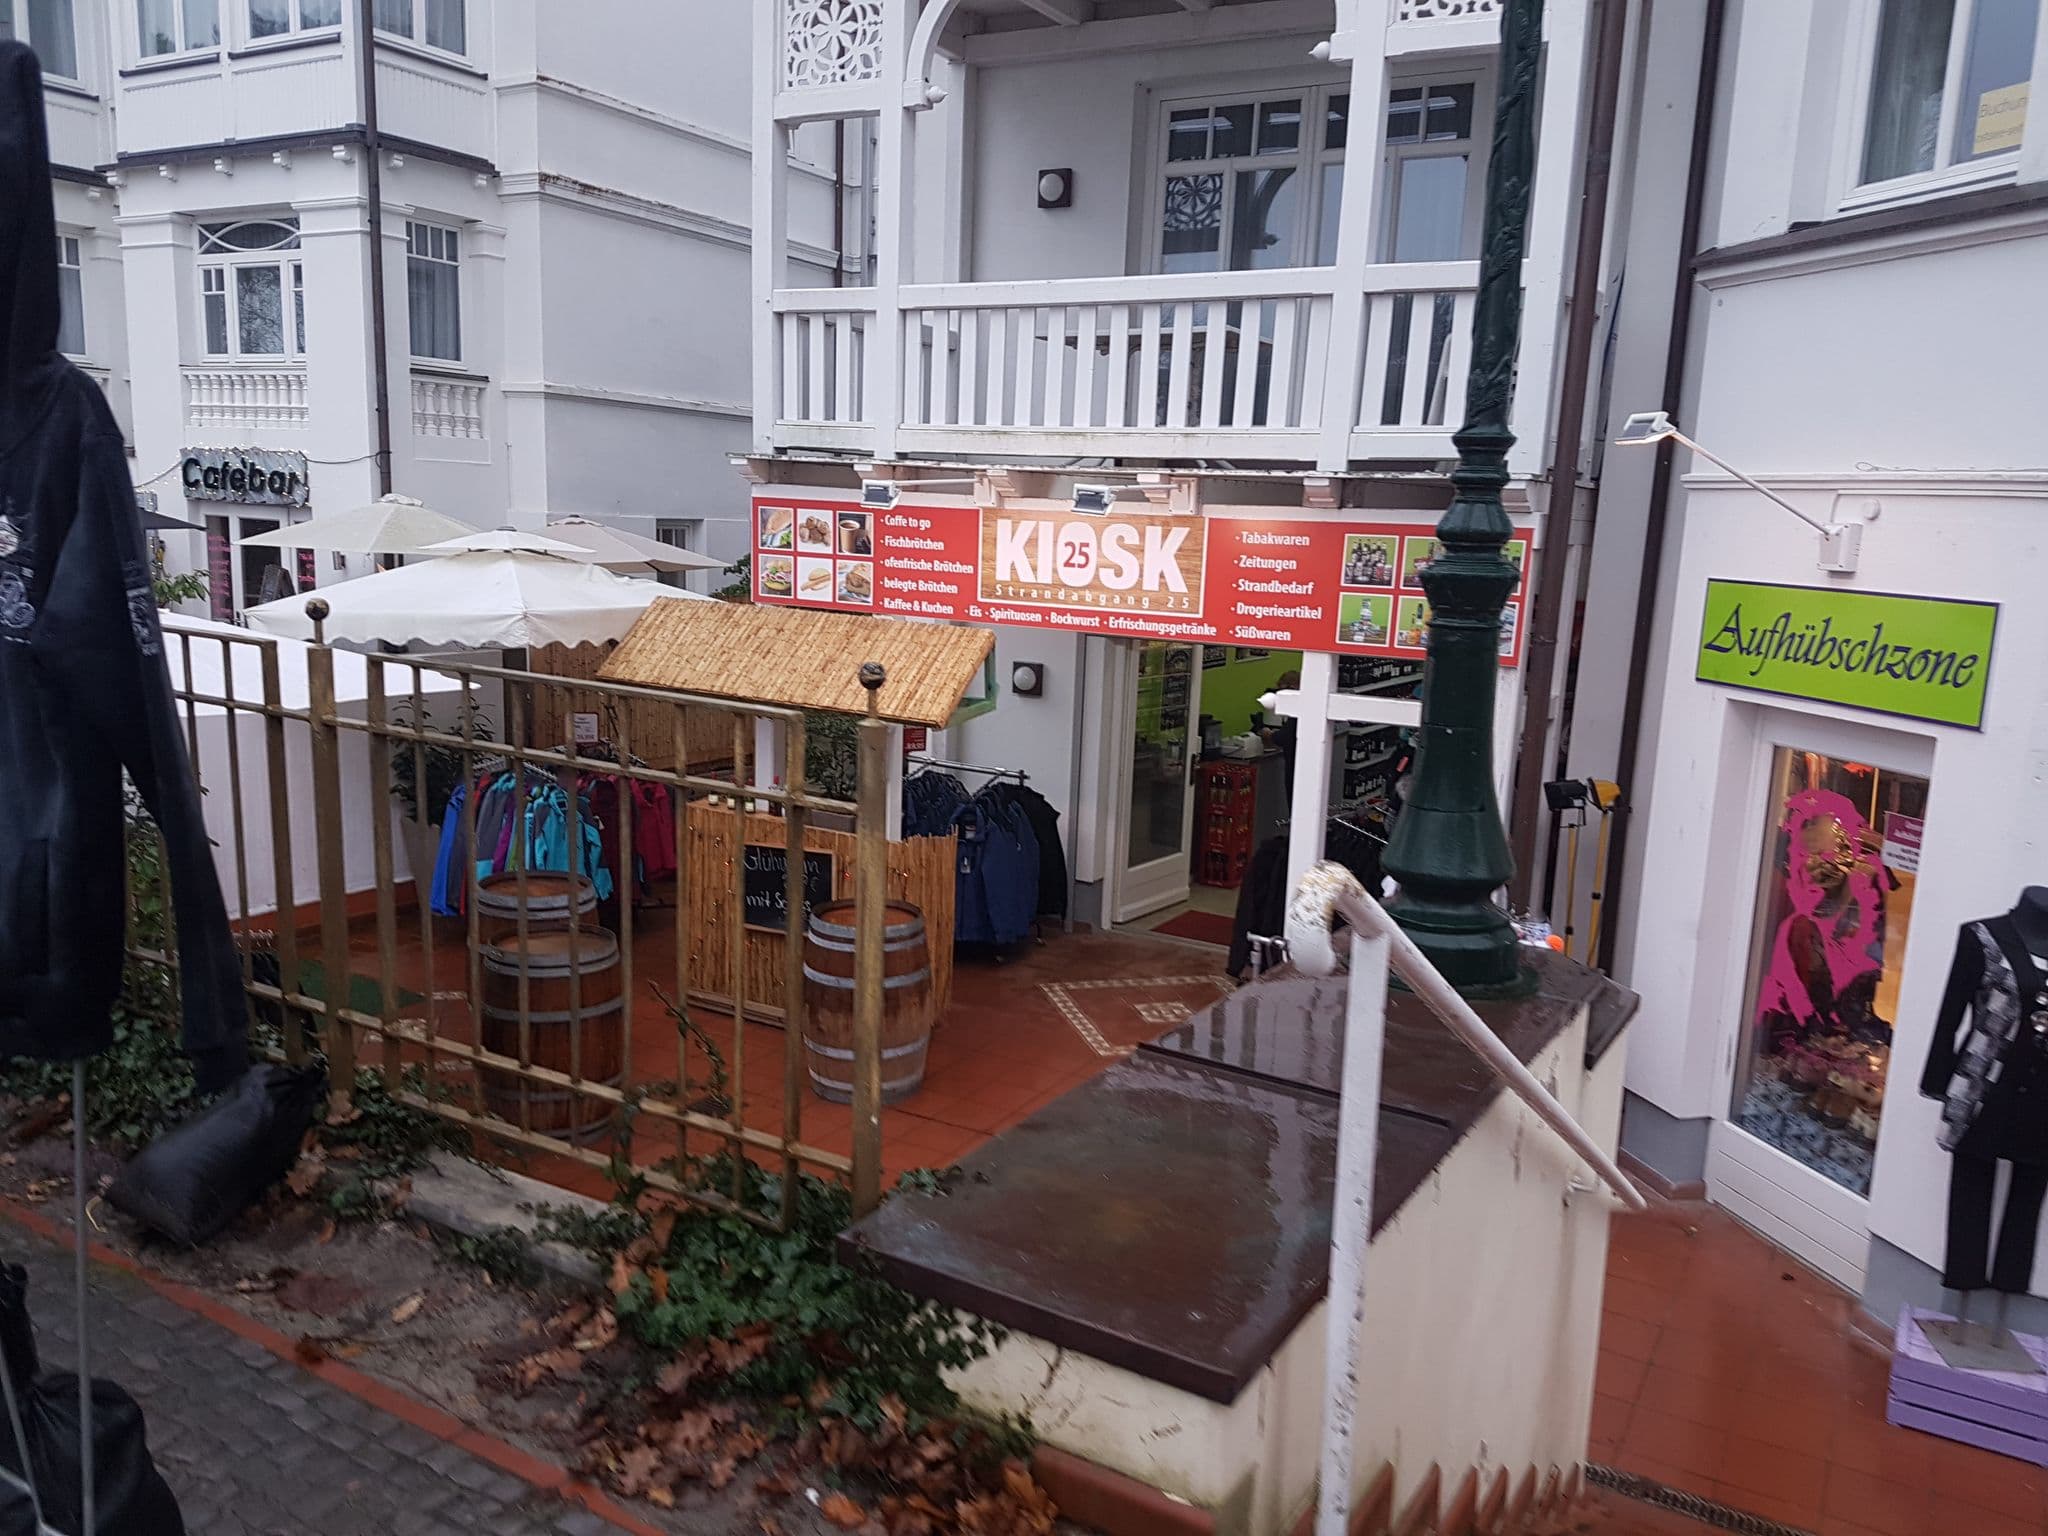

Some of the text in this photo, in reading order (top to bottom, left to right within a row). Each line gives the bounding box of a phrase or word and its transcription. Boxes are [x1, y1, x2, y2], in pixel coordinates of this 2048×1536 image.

[908, 516, 918, 528] to
[919, 519, 931, 531] go
[885, 536, 944, 551] Fischbrötchen
[1241, 531, 1310, 546] Tabakwaren
[996, 519, 1190, 593] KIOSK
[1063, 541, 1090, 569] 25
[1239, 555, 1296, 571] Zeitungen
[884, 556, 974, 574] ofenfrische Brötchen
[884, 576, 958, 594] belegte Brötchen
[1238, 579, 1314, 594] Strandbedarf
[995, 584, 1189, 609] Strandabgang 25
[883, 597, 954, 615] Kaffee & Kuchen
[1236, 602, 1322, 620] Drogerieartikel
[969, 605, 1217, 636] Eis Spirituosen Bockwurst Erfrischungsgetränke
[1234, 625, 1291, 642] Süßwaren
[1704, 603, 1979, 689] Aufhübschzone
